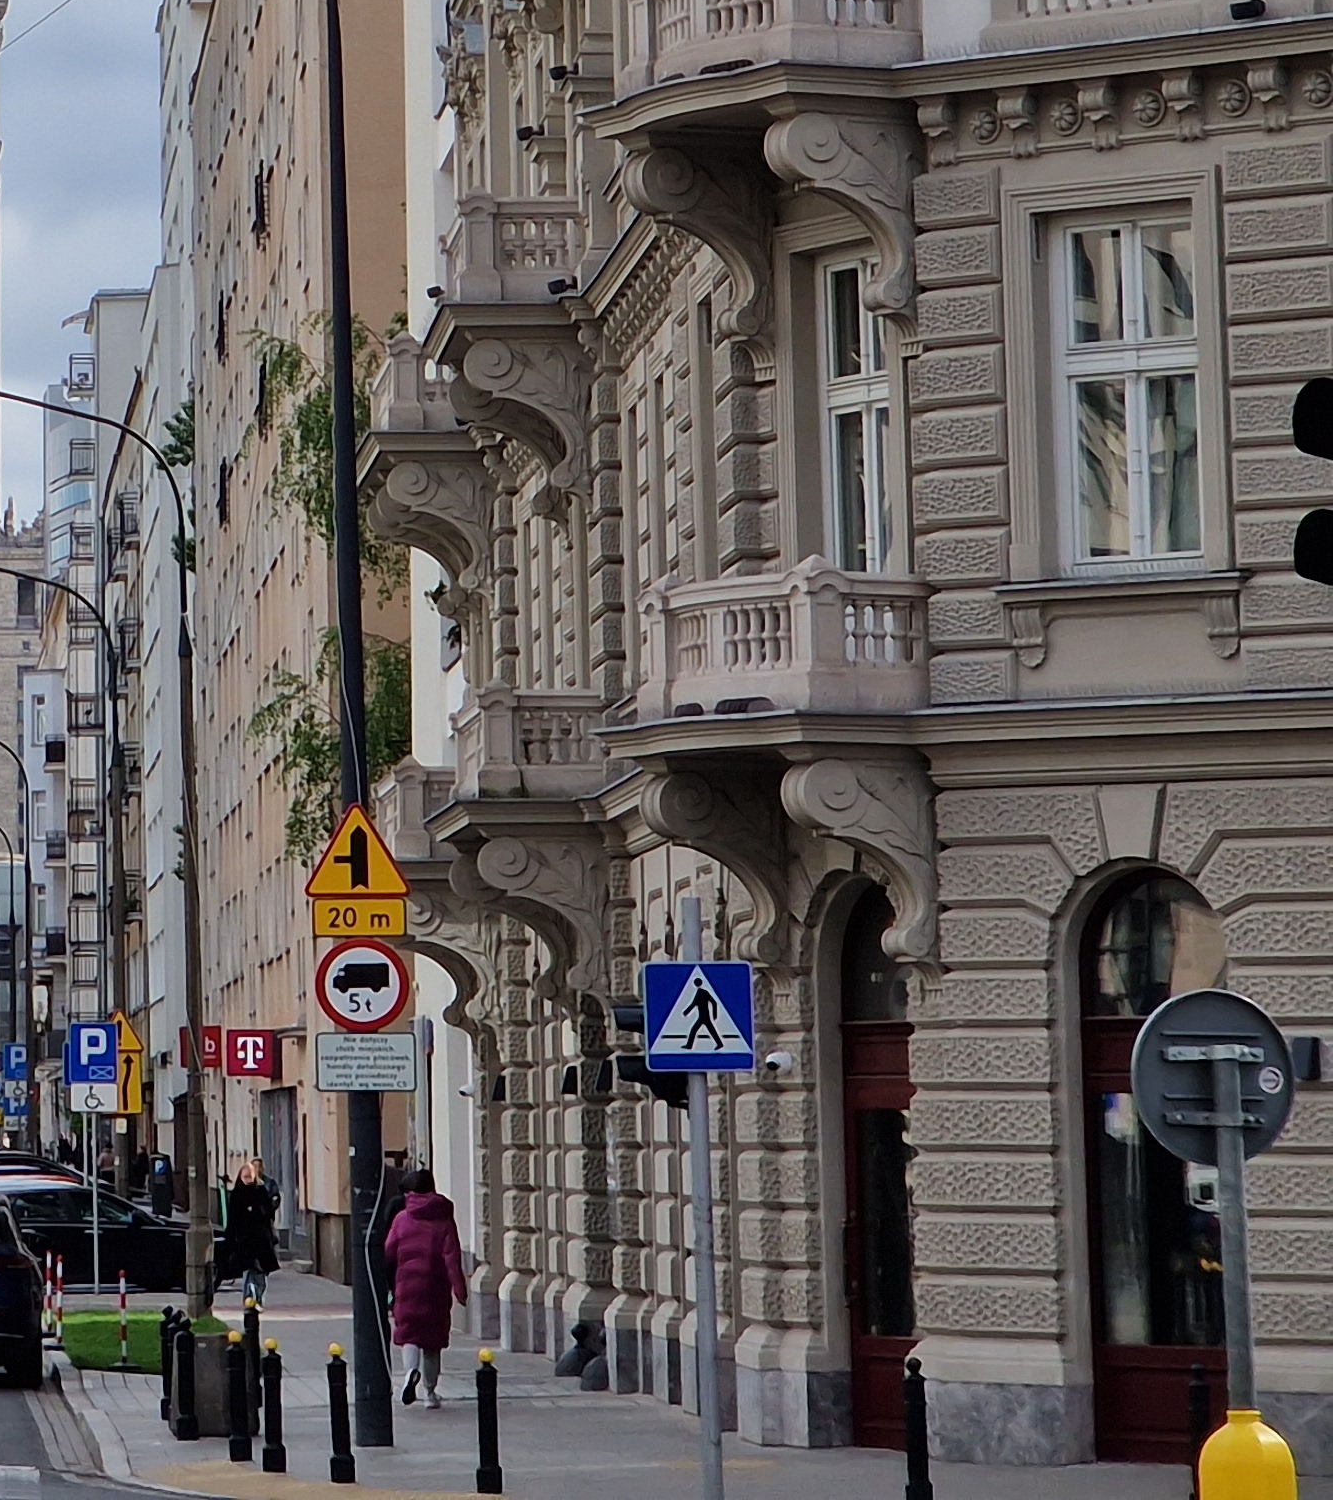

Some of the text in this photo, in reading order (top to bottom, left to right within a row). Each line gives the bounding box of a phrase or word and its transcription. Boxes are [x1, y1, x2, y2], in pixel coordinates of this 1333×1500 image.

[328, 907, 390, 928] 20 m
[349, 993, 372, 1013] 5 t
[10, 1046, 26, 1069] P
[79, 1028, 107, 1065] P
[237, 1037, 263, 1068] T
